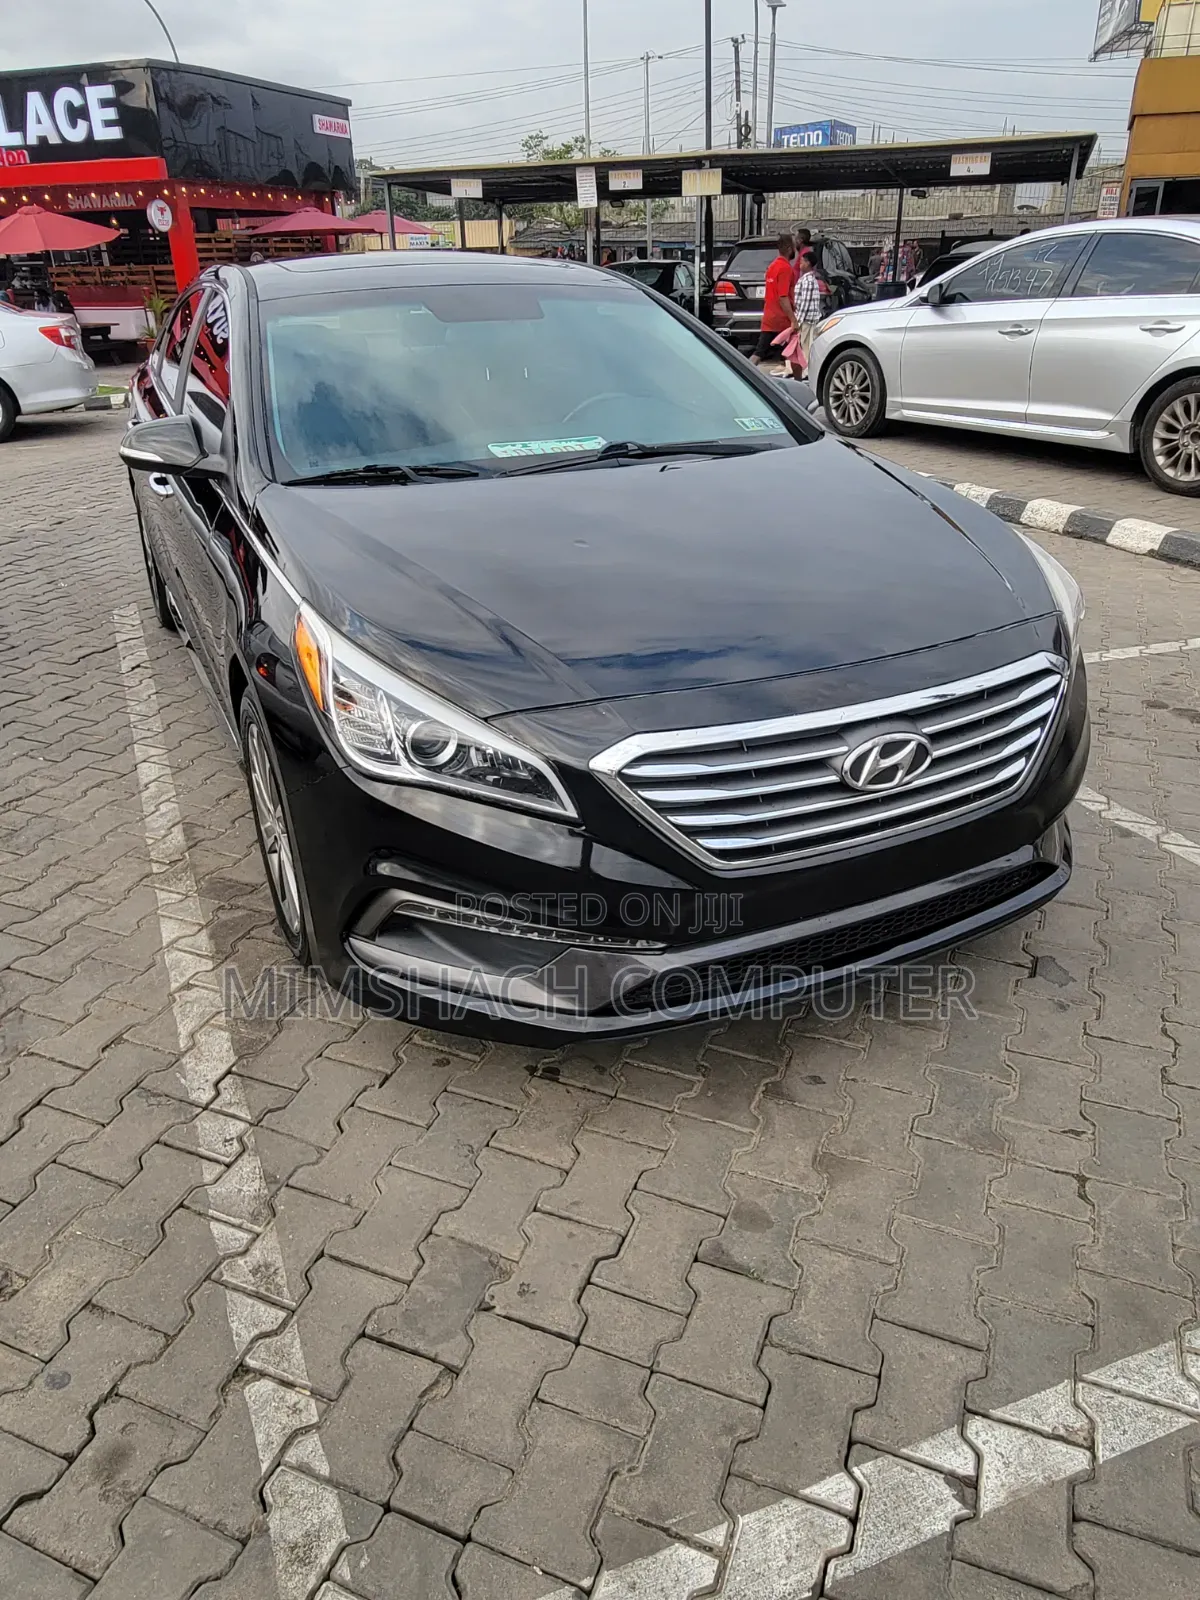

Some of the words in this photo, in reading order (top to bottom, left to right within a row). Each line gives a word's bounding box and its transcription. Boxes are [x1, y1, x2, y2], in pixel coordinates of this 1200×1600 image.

[318, 118, 348, 135] SHAWARMA
[782, 130, 822, 148] TECNO
[836, 130, 853, 146] TECNO
[67, 193, 136, 210] SHAWARMA
